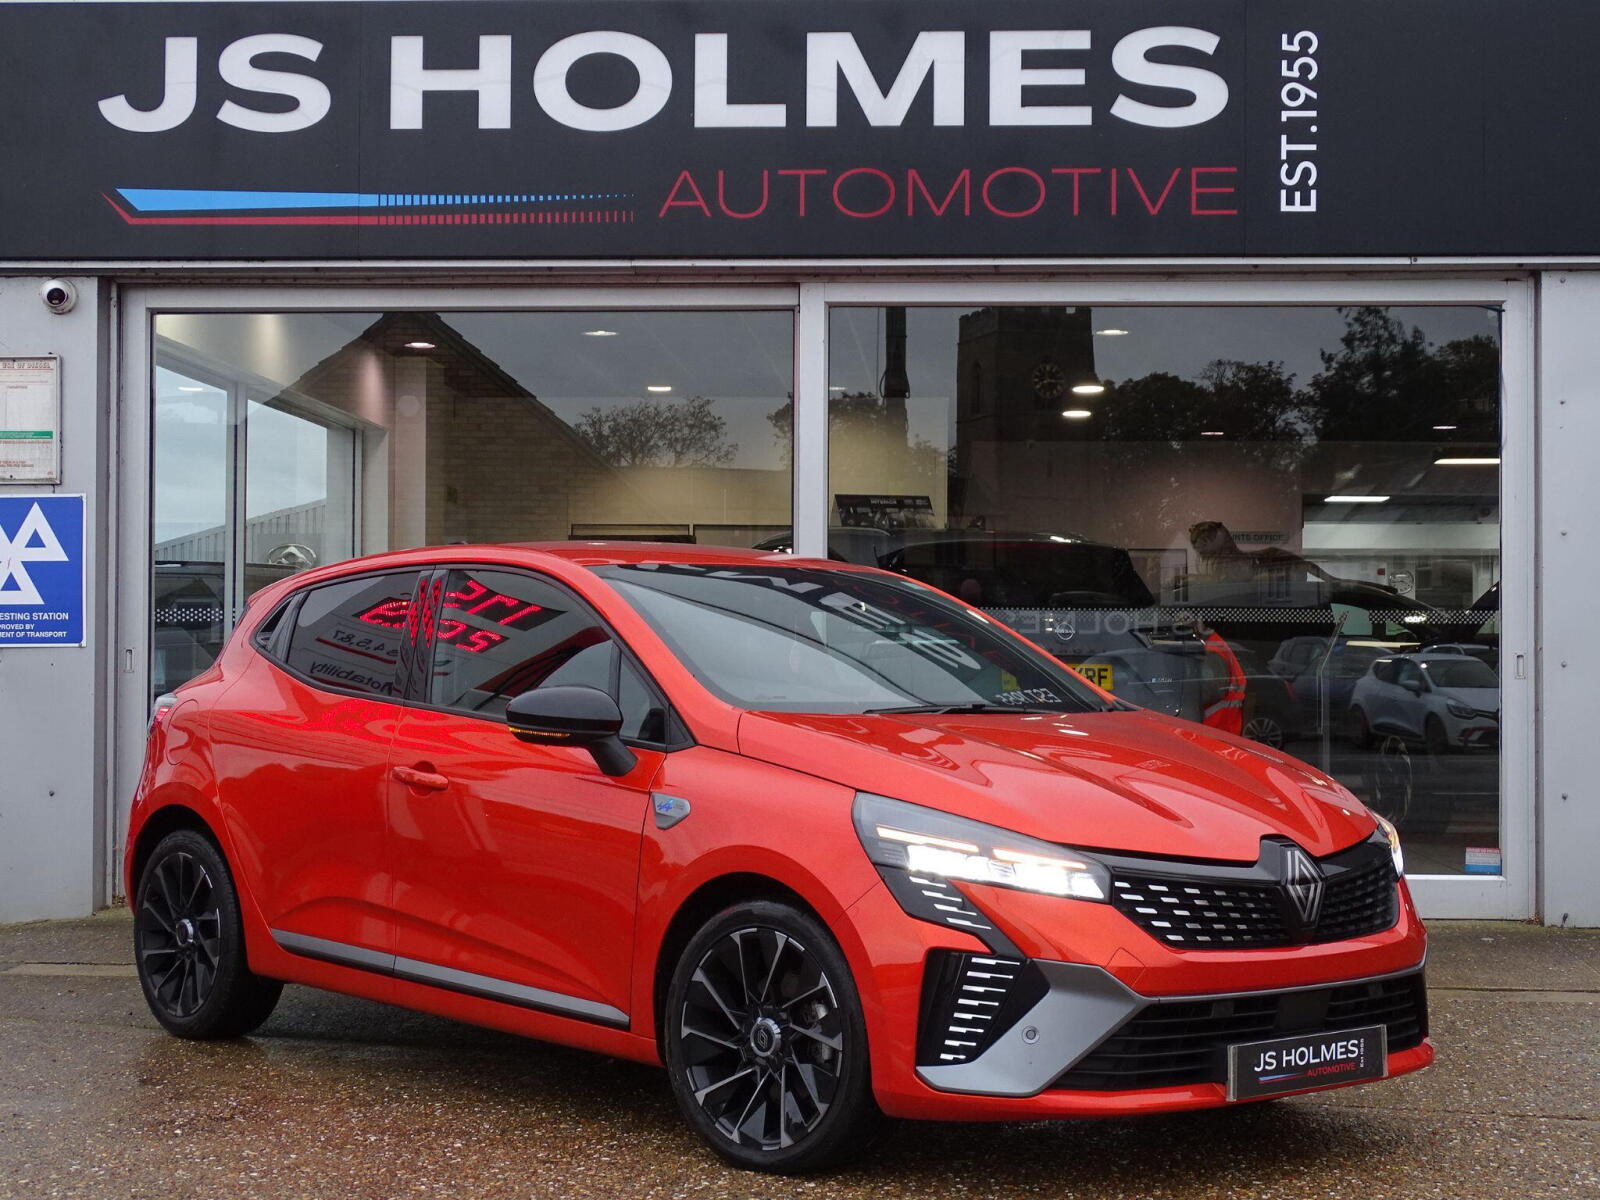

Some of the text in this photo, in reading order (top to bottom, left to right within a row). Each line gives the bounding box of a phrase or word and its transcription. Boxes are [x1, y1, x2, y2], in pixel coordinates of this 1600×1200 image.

[98, 26, 1230, 133] JS HOLMES
[1280, 29, 1319, 213] EST.1955
[658, 166, 1239, 219] AUTOMOTIVE
[32, 612, 69, 620] STATION
[1254, 1039, 1359, 1072] JS HOLMES
[1306, 1062, 1357, 1078] AUTOMOTIVE
